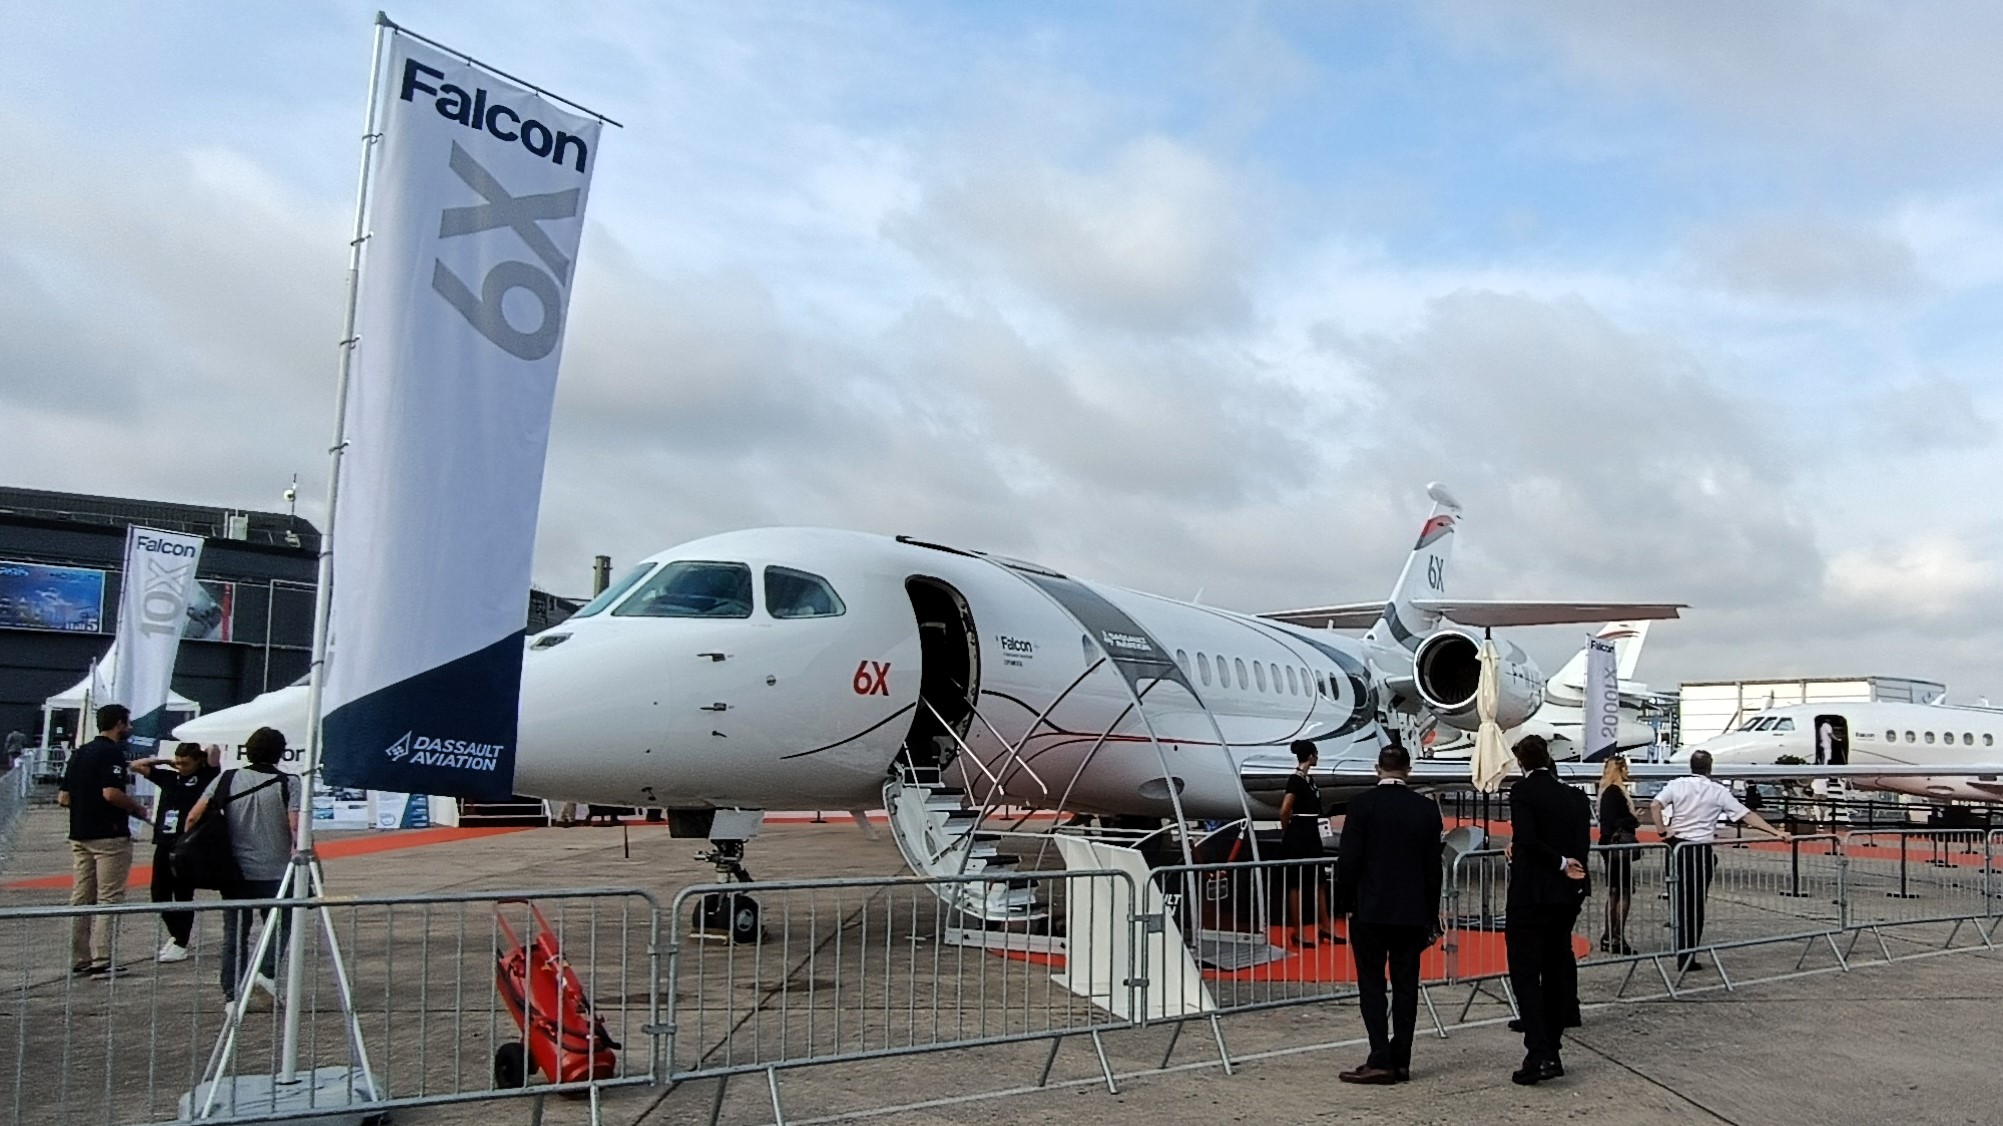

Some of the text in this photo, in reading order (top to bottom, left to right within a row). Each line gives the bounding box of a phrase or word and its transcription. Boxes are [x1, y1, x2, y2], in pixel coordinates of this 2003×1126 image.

[400, 58, 588, 173] Falcon
[431, 139, 581, 361] 6X
[136, 535, 196, 558] Falcon
[1427, 554, 1445, 593] 6X
[138, 557, 192, 640] 10X
[86, 618, 98, 632] 5
[1000, 635, 1033, 653] Falcon
[853, 659, 891, 697] 6X
[409, 751, 497, 771] AVIATION
[413, 736, 504, 758] DASSAULT
